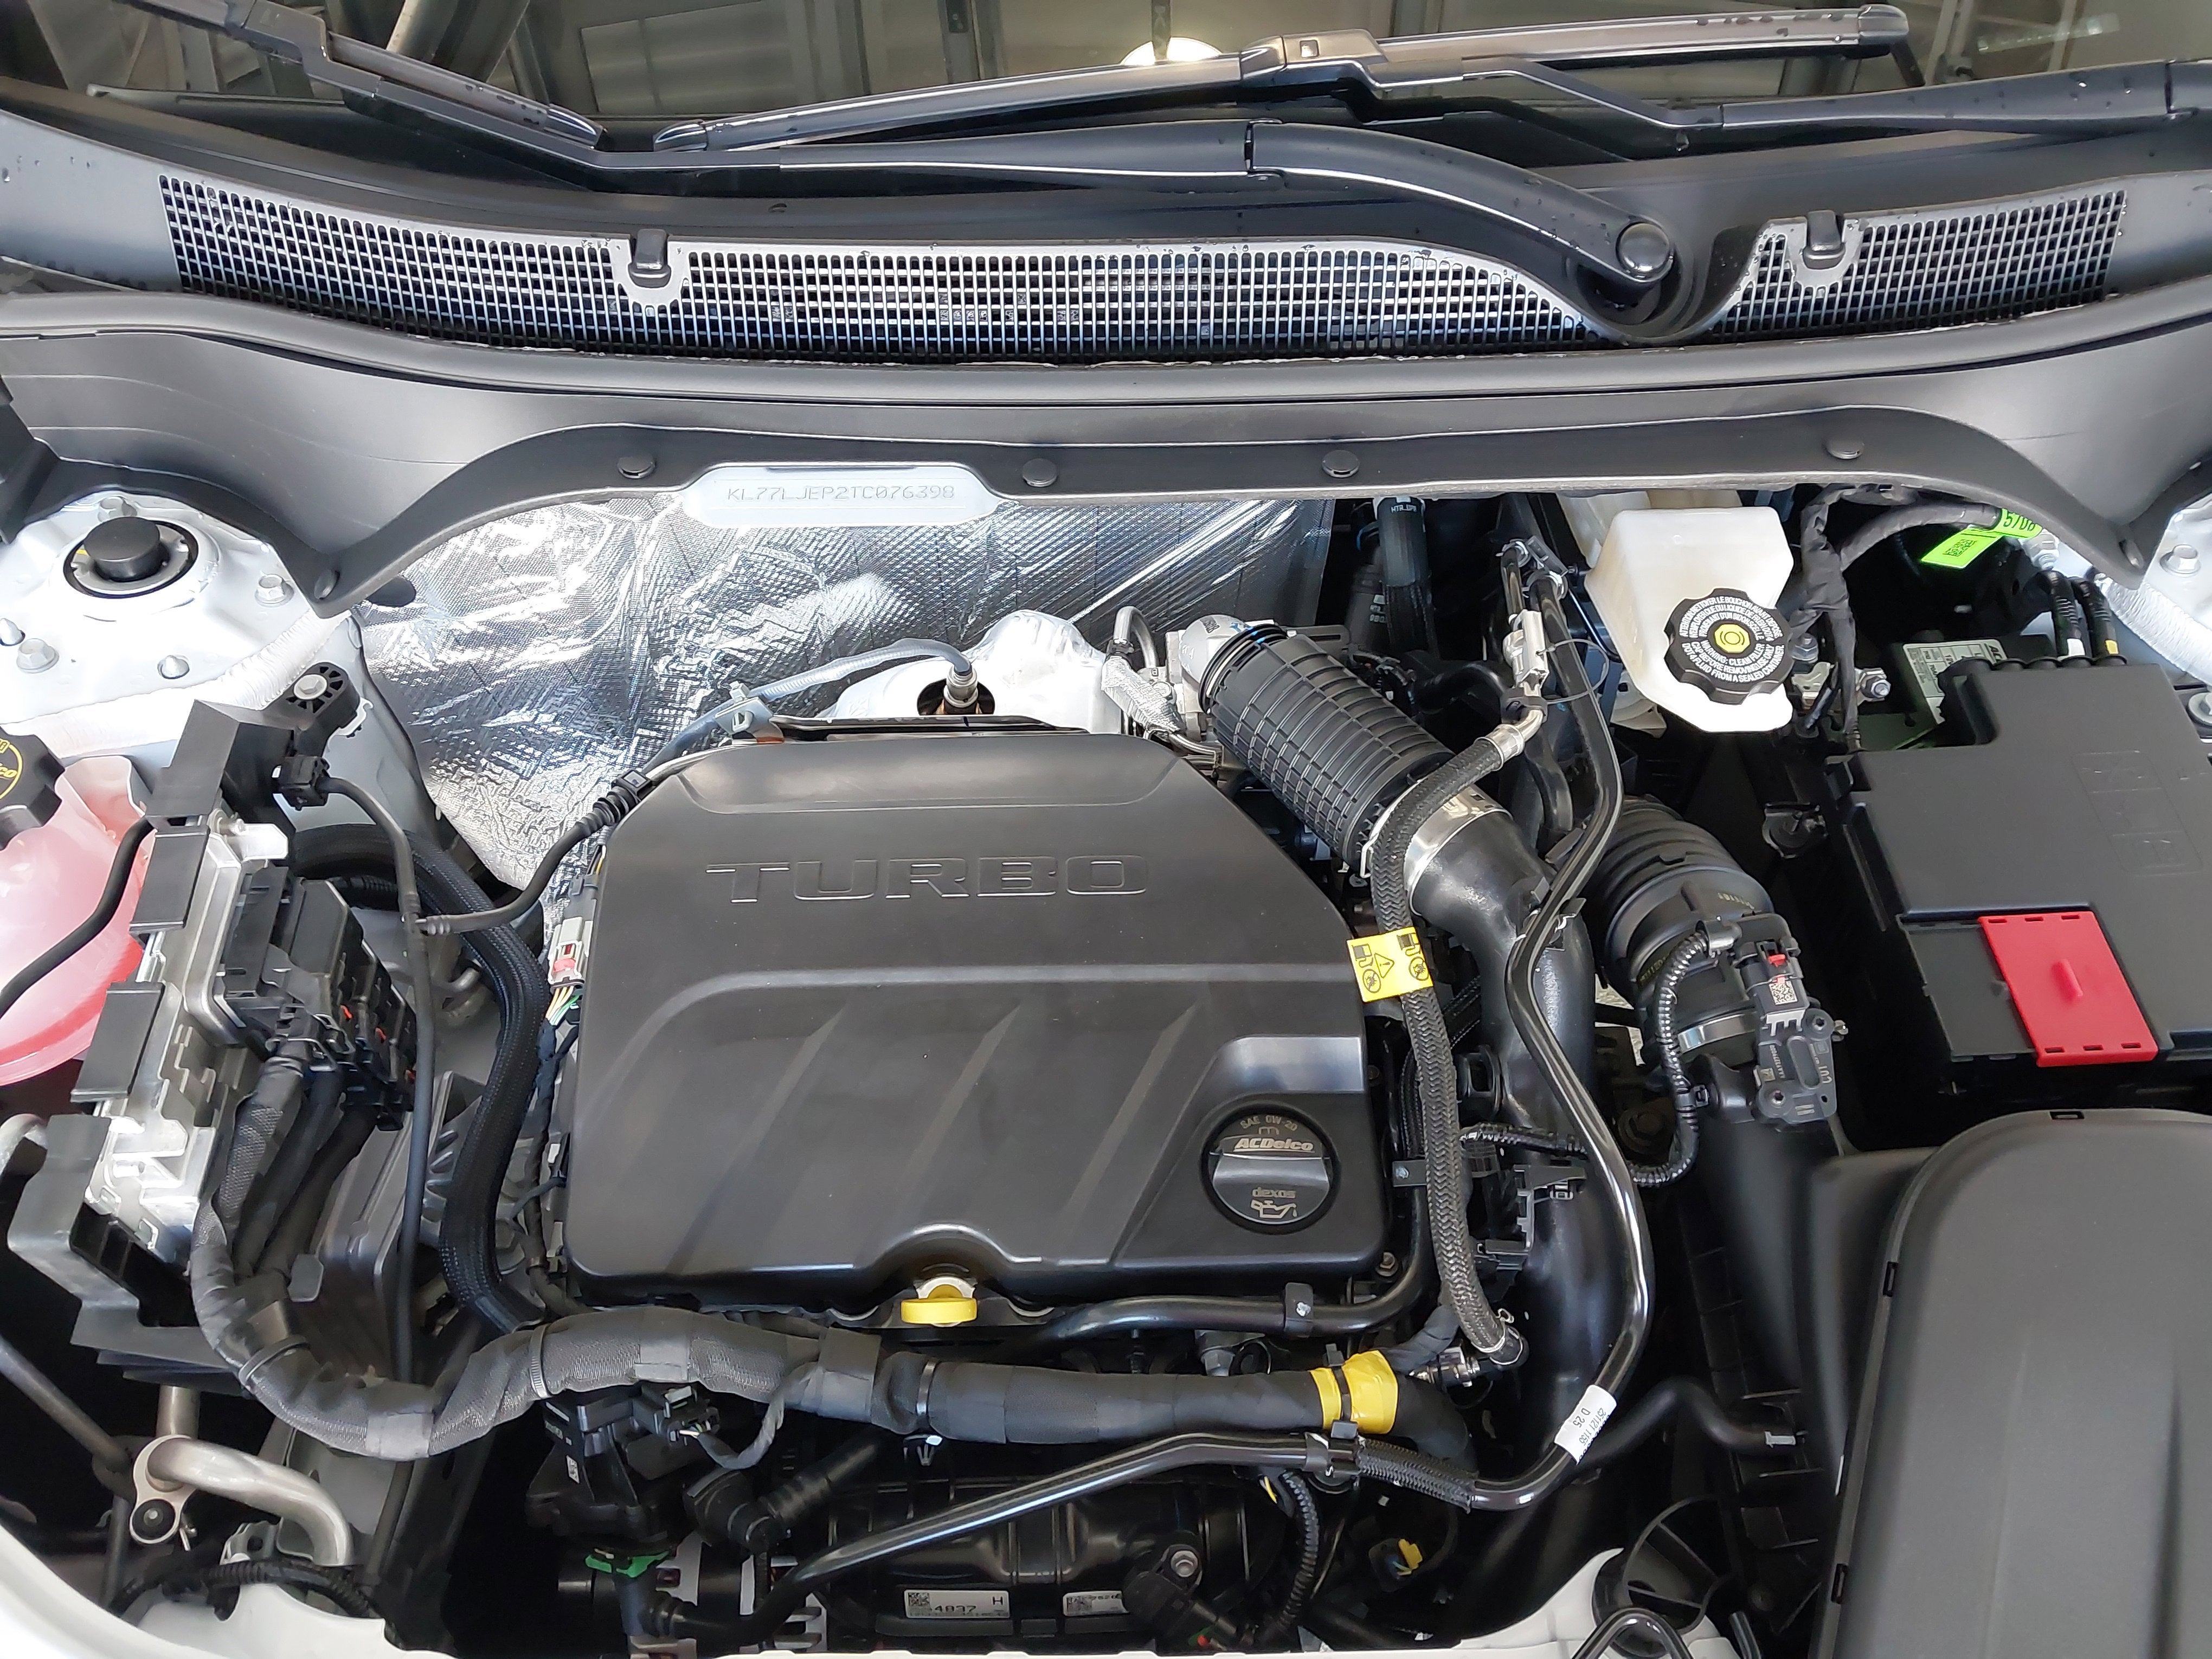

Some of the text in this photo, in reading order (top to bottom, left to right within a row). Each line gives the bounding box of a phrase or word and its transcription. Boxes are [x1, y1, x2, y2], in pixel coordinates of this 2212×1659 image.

[728, 486, 954, 500] KL77LJEP2TC076398
[1692, 642, 1704, 653] CAP
[1699, 652, 1725, 671] BEFORE
[1729, 657, 1753, 666] CLEAN
[1748, 644, 1765, 661] FILLER
[1692, 657, 1712, 673] FLUID
[1711, 669, 1732, 681] FROM
[1738, 671, 1765, 682] SEALED
[706, 855, 1147, 903] TURBO
[1240, 1116, 1261, 1129] SAE
[1235, 1138, 1314, 1152] ACDelco
[1252, 1187, 1297, 1198] dexos
[1572, 1416, 1585, 1428] 25
